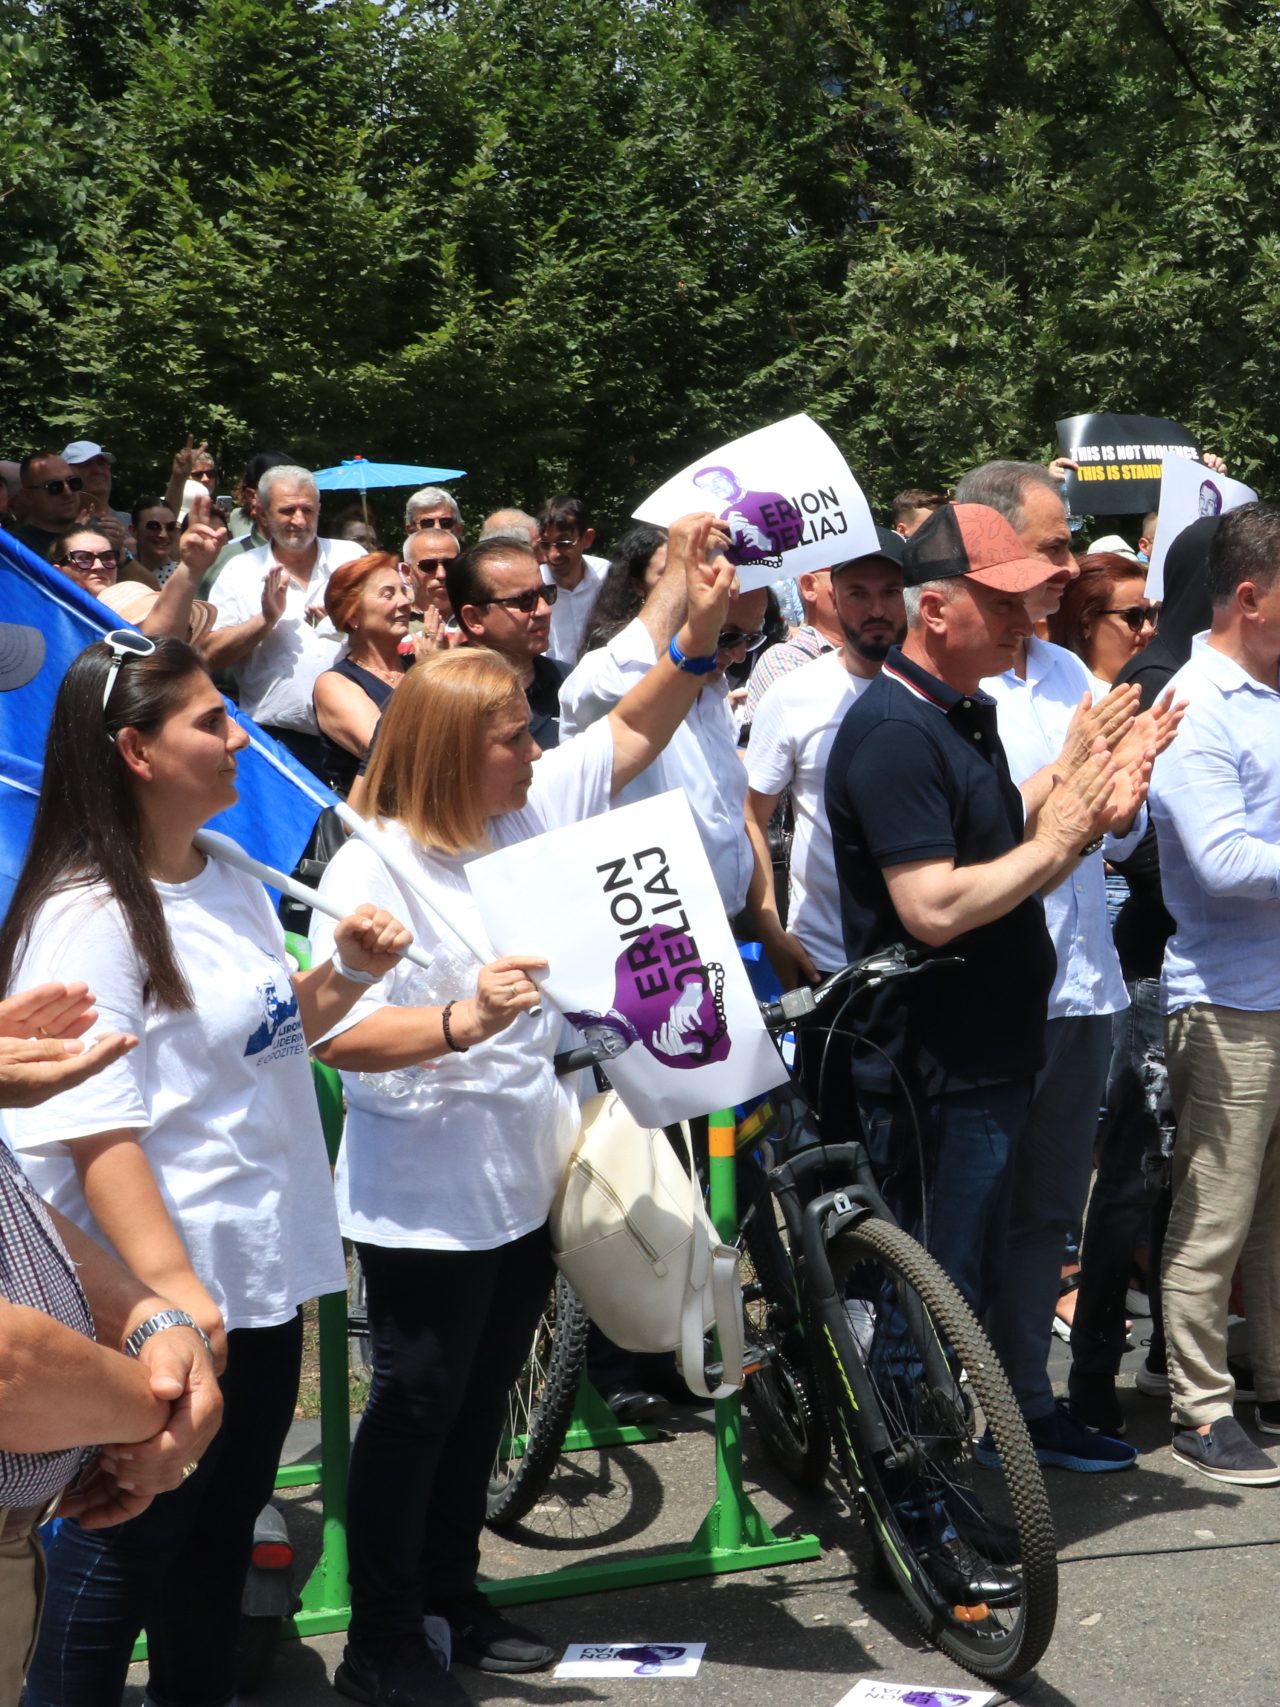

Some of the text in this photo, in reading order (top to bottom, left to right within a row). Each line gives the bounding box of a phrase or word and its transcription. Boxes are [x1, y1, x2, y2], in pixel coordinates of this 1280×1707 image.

[1070, 445, 1100, 462] THIS
[1101, 445, 1116, 461] IS
[1117, 445, 1141, 461] NOT
[1077, 465, 1106, 481] THIS
[1107, 465, 1121, 480] IS
[759, 486, 840, 528] ERION
[766, 511, 848, 553] DELIAJ
[596, 857, 670, 1000] ERION
[632, 846, 710, 994] DELIAJ
